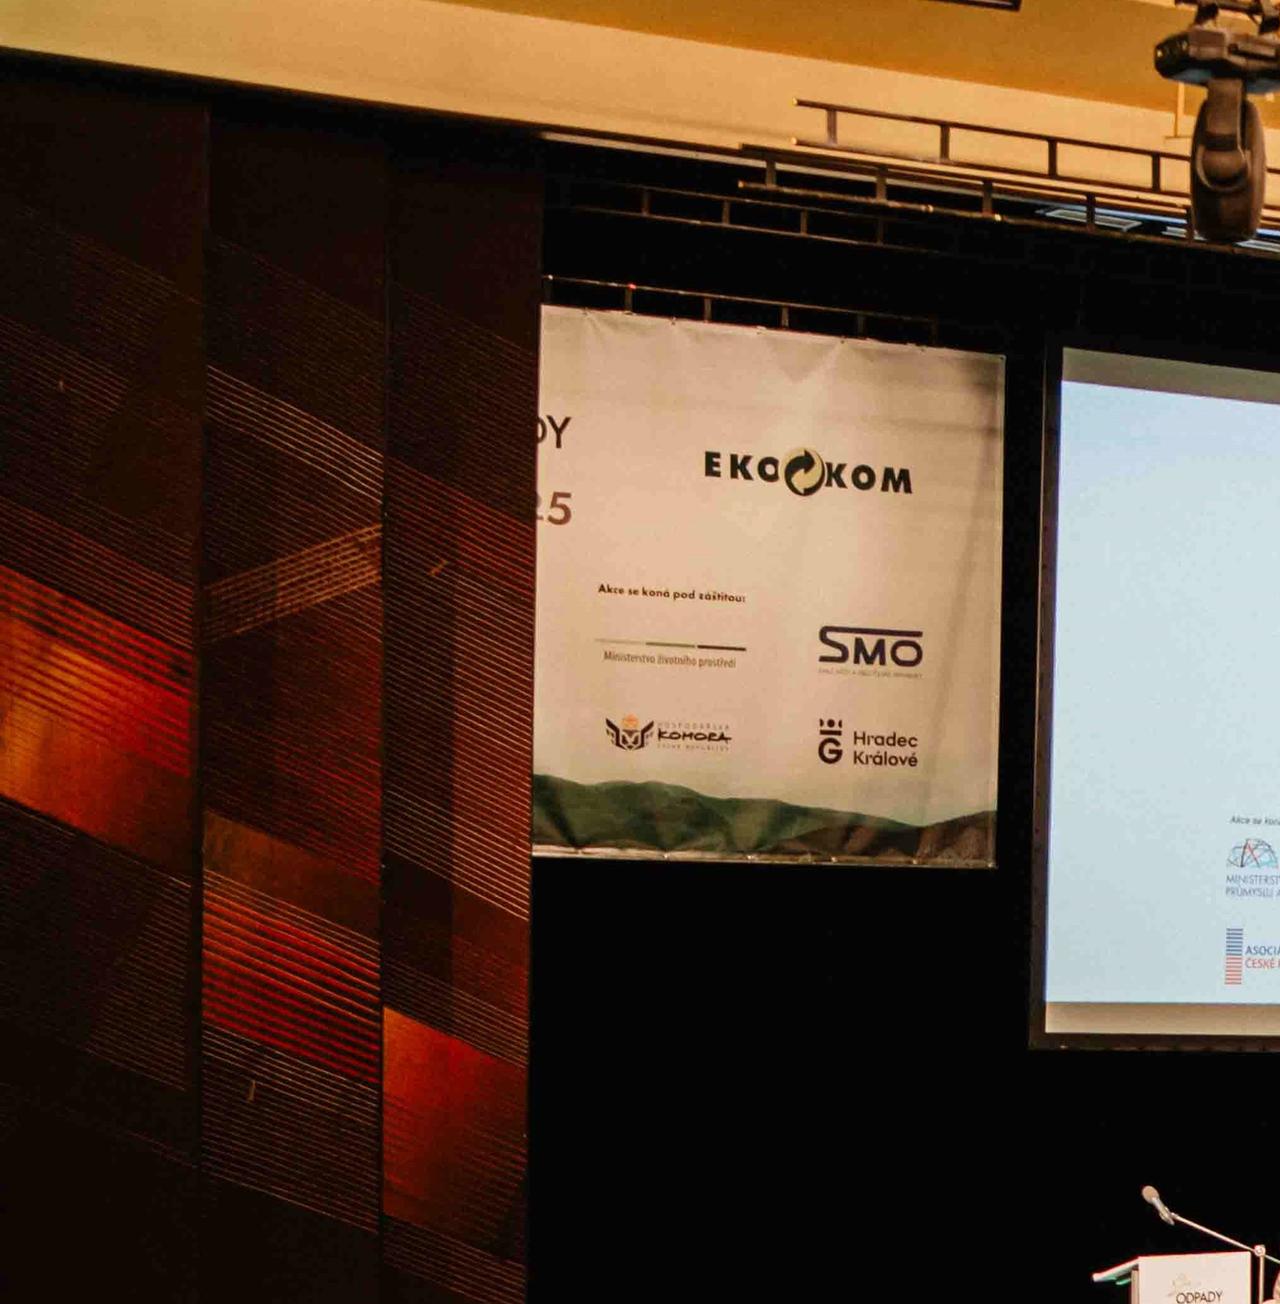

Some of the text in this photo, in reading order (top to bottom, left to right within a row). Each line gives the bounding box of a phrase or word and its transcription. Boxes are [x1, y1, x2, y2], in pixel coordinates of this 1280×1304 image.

[537, 491, 572, 526] 5
[598, 583, 625, 594] Akce
[628, 587, 639, 595] se
[641, 586, 670, 598] koná
[672, 589, 696, 601] pod
[818, 626, 924, 667] SMO
[603, 650, 656, 664] Ministerstvo
[657, 728, 733, 744] KOMORA
[853, 731, 919, 748] Hradec
[853, 750, 919, 767] Králové
[1175, 1290, 1223, 1304] ODPADY
